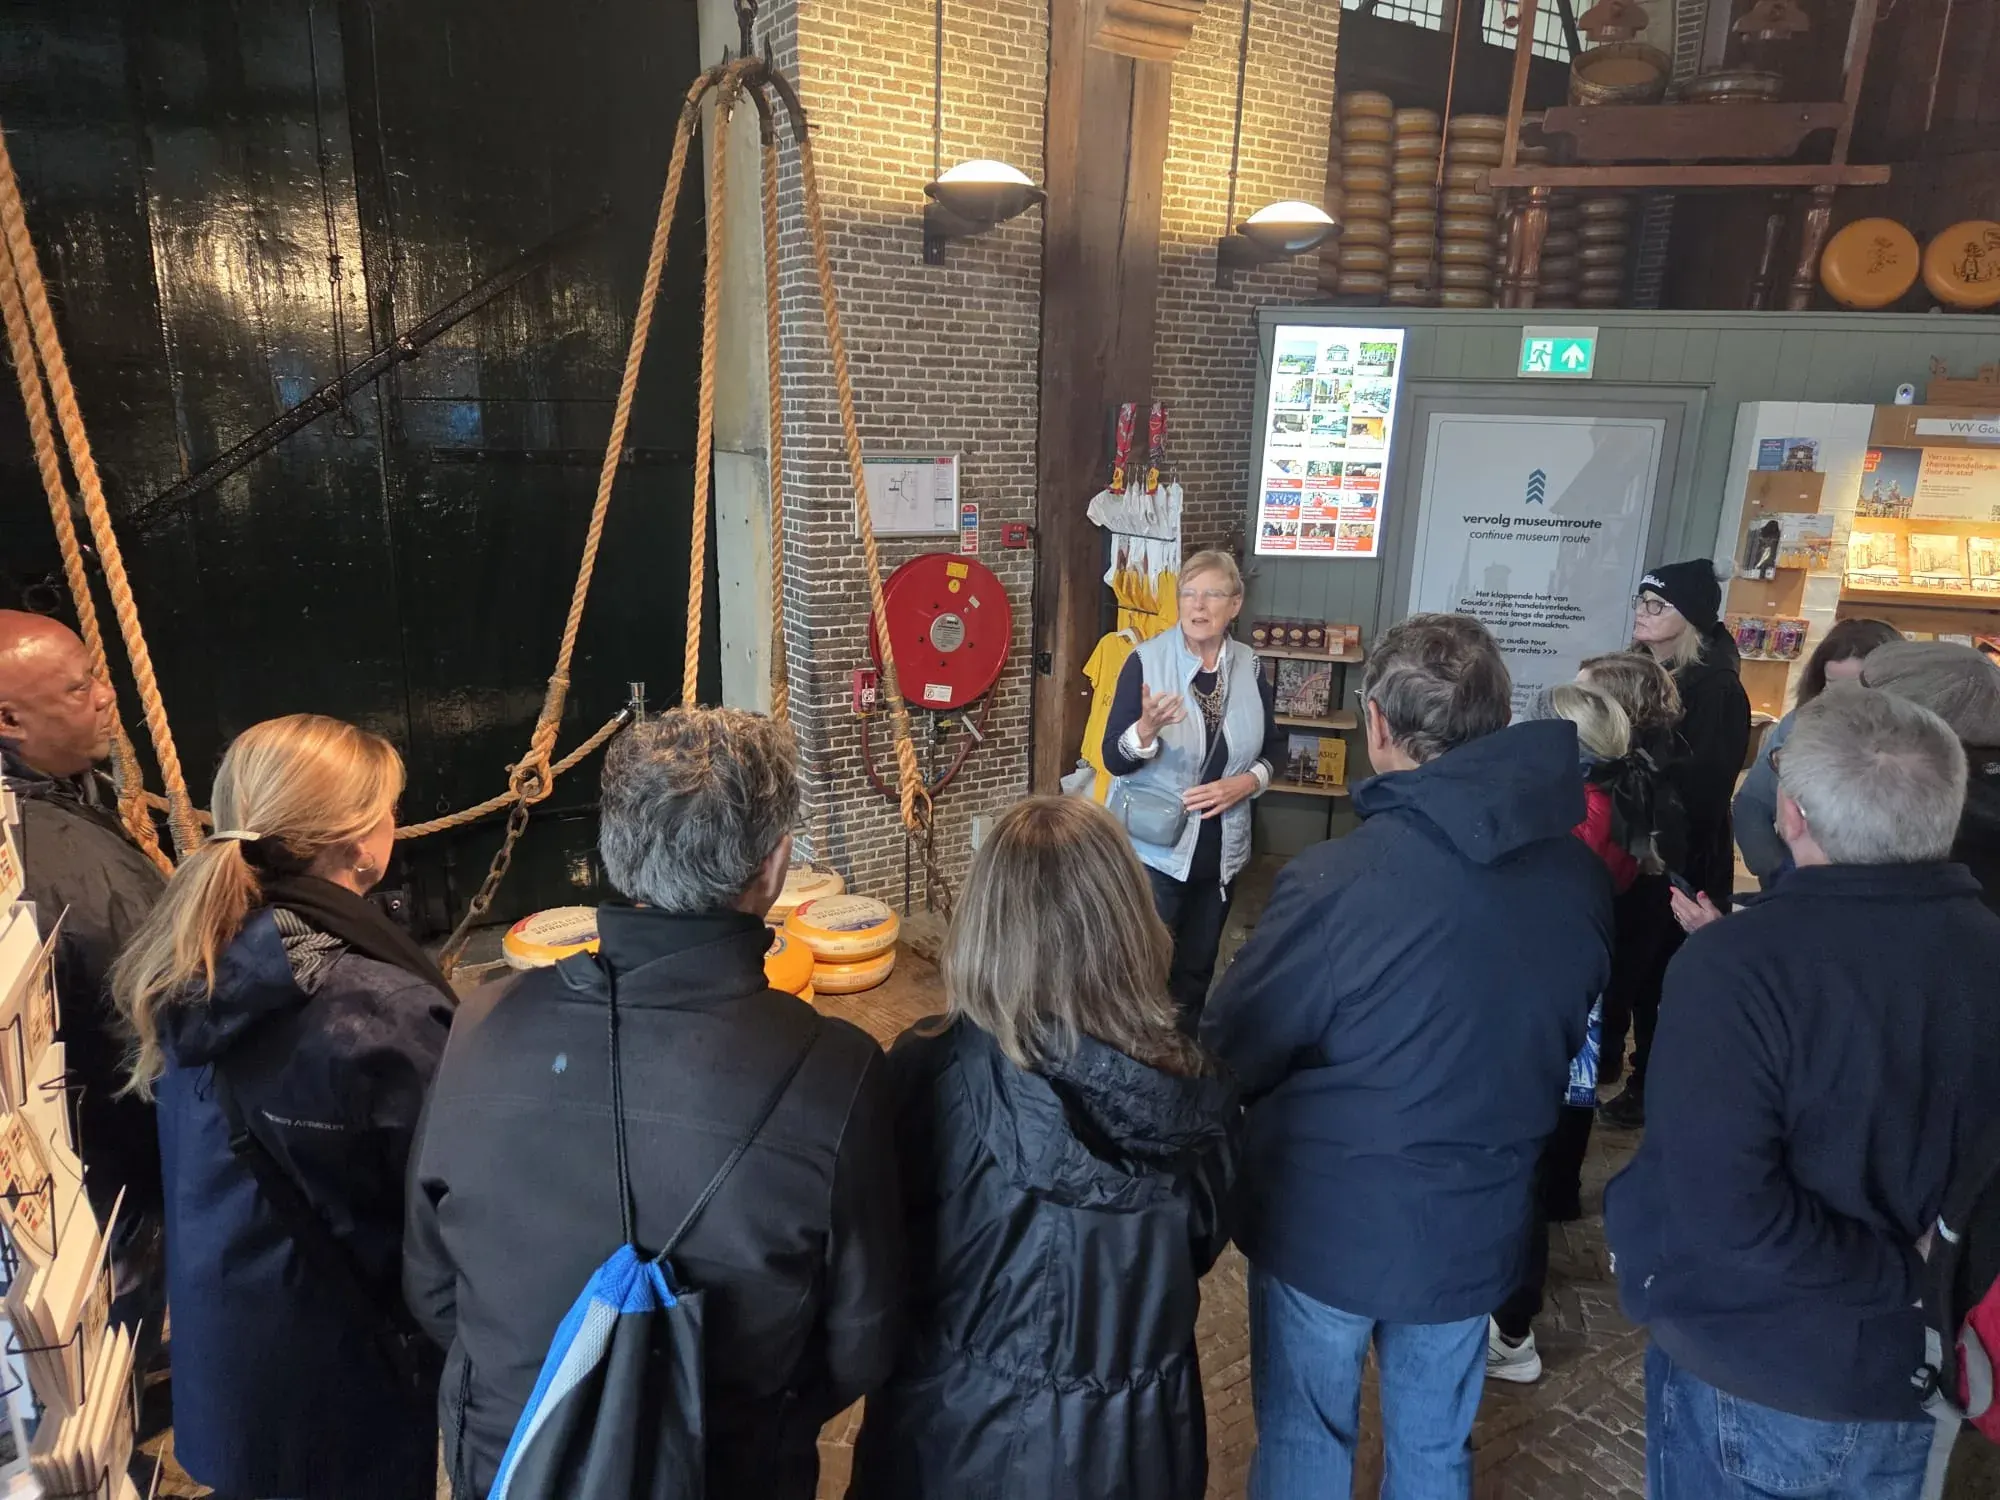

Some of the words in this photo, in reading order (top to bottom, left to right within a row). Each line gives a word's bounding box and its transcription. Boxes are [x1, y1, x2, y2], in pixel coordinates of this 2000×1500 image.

[1949, 422, 1975, 432] VVV
[1463, 513, 1511, 528] vervolg
[1513, 517, 1602, 529] museumroute
[1469, 529, 1513, 540] continue
[1515, 533, 1559, 543] museum
[1562, 534, 1591, 544] route
[1475, 590, 1489, 598] Het
[1491, 591, 1533, 600] kloppende
[1535, 593, 1552, 601] hart
[1460, 598, 1493, 607] Gouda's
[1495, 601, 1513, 609] rijke
[1514, 602, 1581, 612] handelsverleden.
[1455, 607, 1476, 615] Maak
[1495, 609, 1509, 617] reis
[1511, 610, 1532, 620] langs
[1533, 611, 1544, 619] de
[1545, 613, 1586, 622] producten
[1481, 617, 1508, 626] Gouda
[1509, 620, 1531, 628] groot
[1532, 621, 1570, 629] maakten.
[1506, 637, 1529, 645] audio
[1517, 647, 1541, 655] rechts
